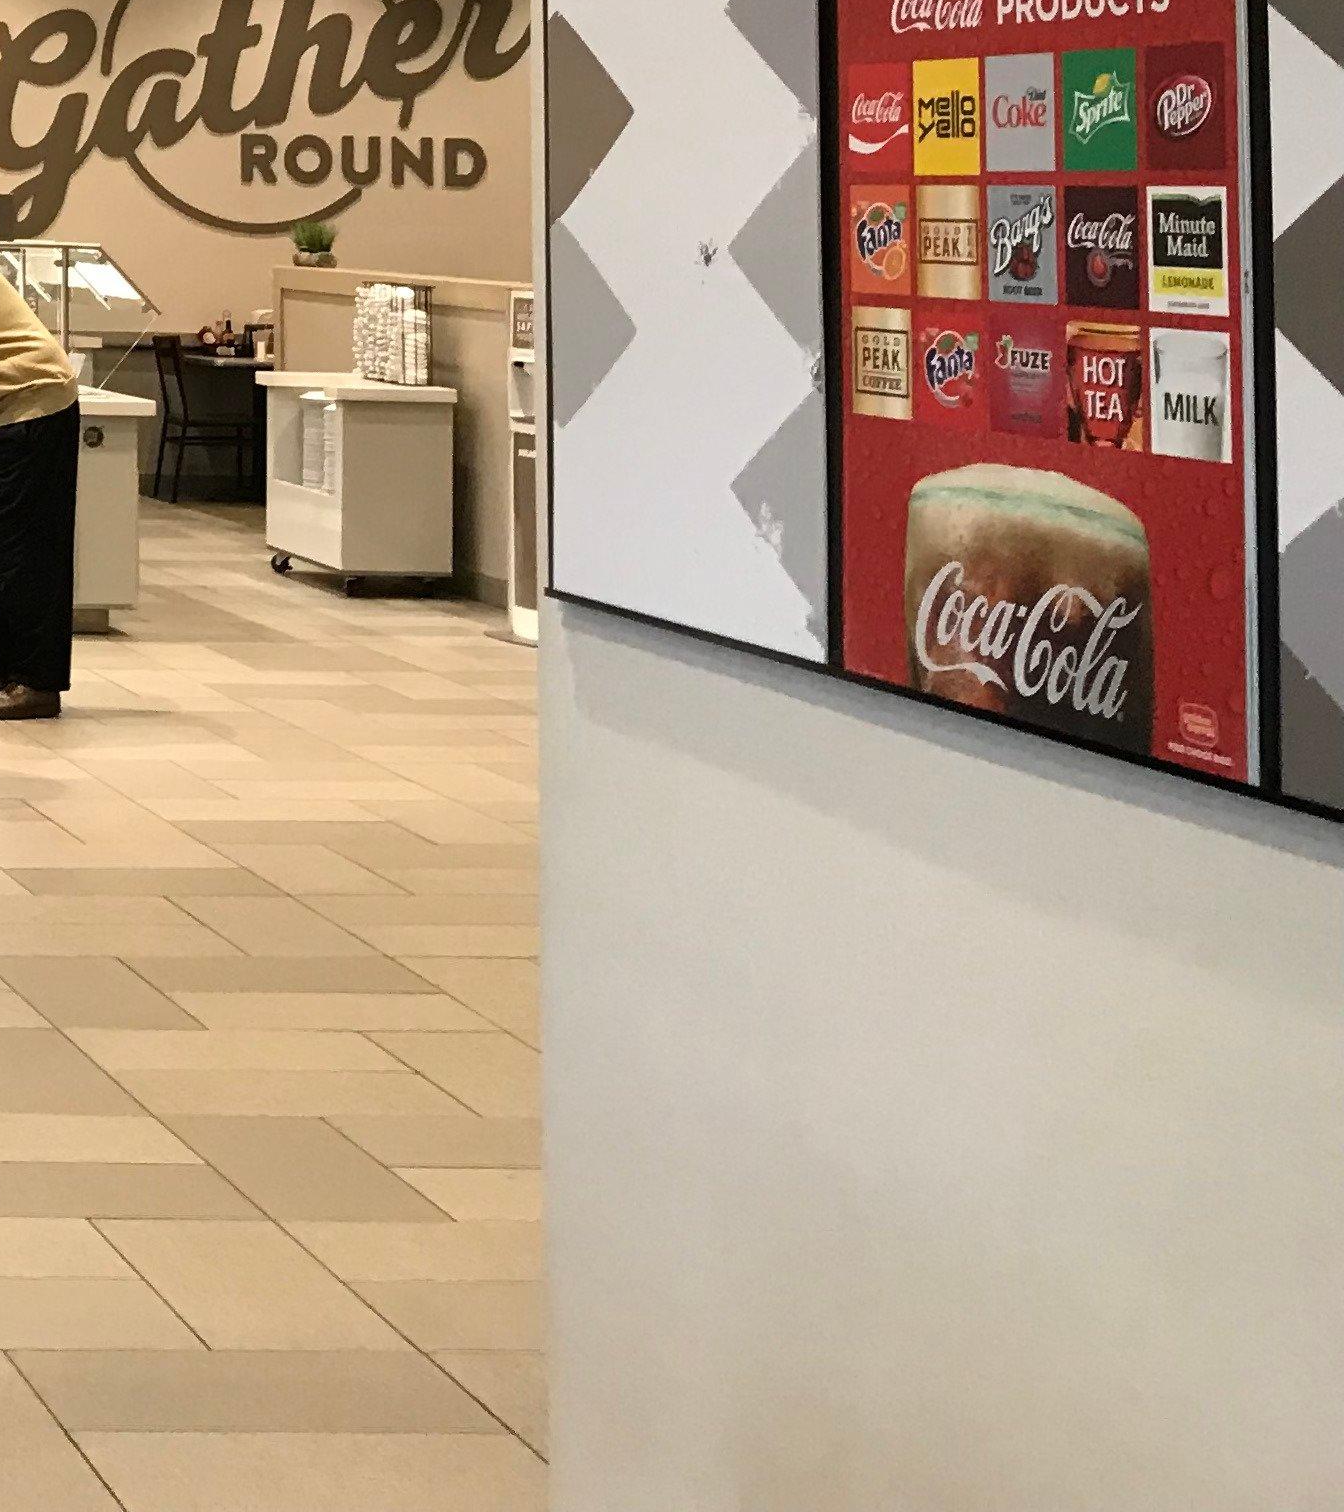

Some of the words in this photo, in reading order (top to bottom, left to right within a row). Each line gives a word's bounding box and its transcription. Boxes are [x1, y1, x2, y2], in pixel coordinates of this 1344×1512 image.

[852, 91, 905, 125] Coca-Cola
[1174, 82, 1195, 103] Dr
[992, 93, 1048, 129] Coke
[1076, 87, 1125, 133] Sprite
[1157, 91, 1210, 131] Pepper
[240, 134, 488, 189] ROUND
[1067, 213, 1135, 248] Coca-Cola
[1157, 211, 1216, 235] Minute
[923, 236, 961, 258] PEAK
[1166, 234, 1209, 259] Maid
[862, 346, 901, 373] PEAK
[1010, 350, 1050, 371] FUZE
[1083, 356, 1126, 386] HOT
[862, 374, 902, 391] COFFEE
[1084, 389, 1124, 423] TEA
[1163, 391, 1218, 427] MILK
[916, 561, 1143, 720] Coca-Cola
